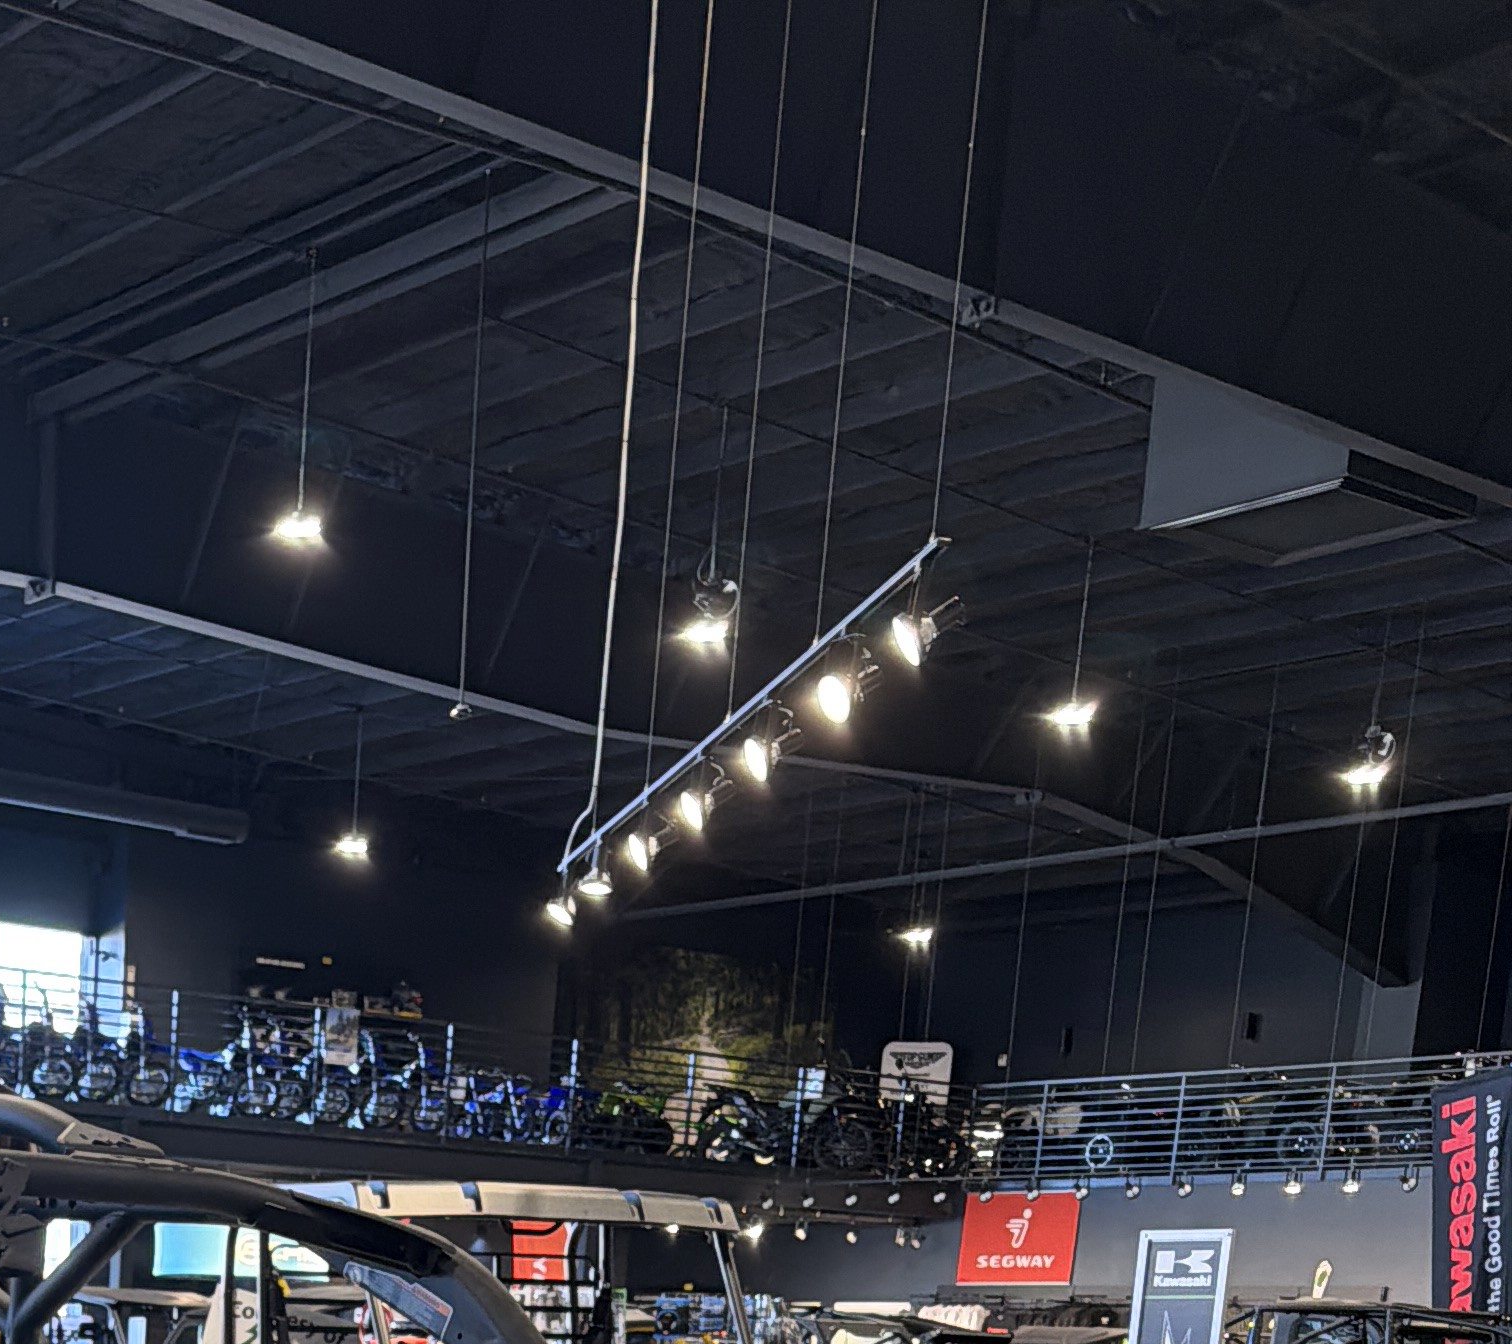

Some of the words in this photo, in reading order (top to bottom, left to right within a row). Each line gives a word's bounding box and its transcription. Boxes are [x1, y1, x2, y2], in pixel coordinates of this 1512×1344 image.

[1483, 1145, 1501, 1213] Times
[975, 1254, 1056, 1269] SEGWAY
[1483, 1214, 1503, 1273] Good
[1152, 1274, 1212, 1288] Kawasaki
